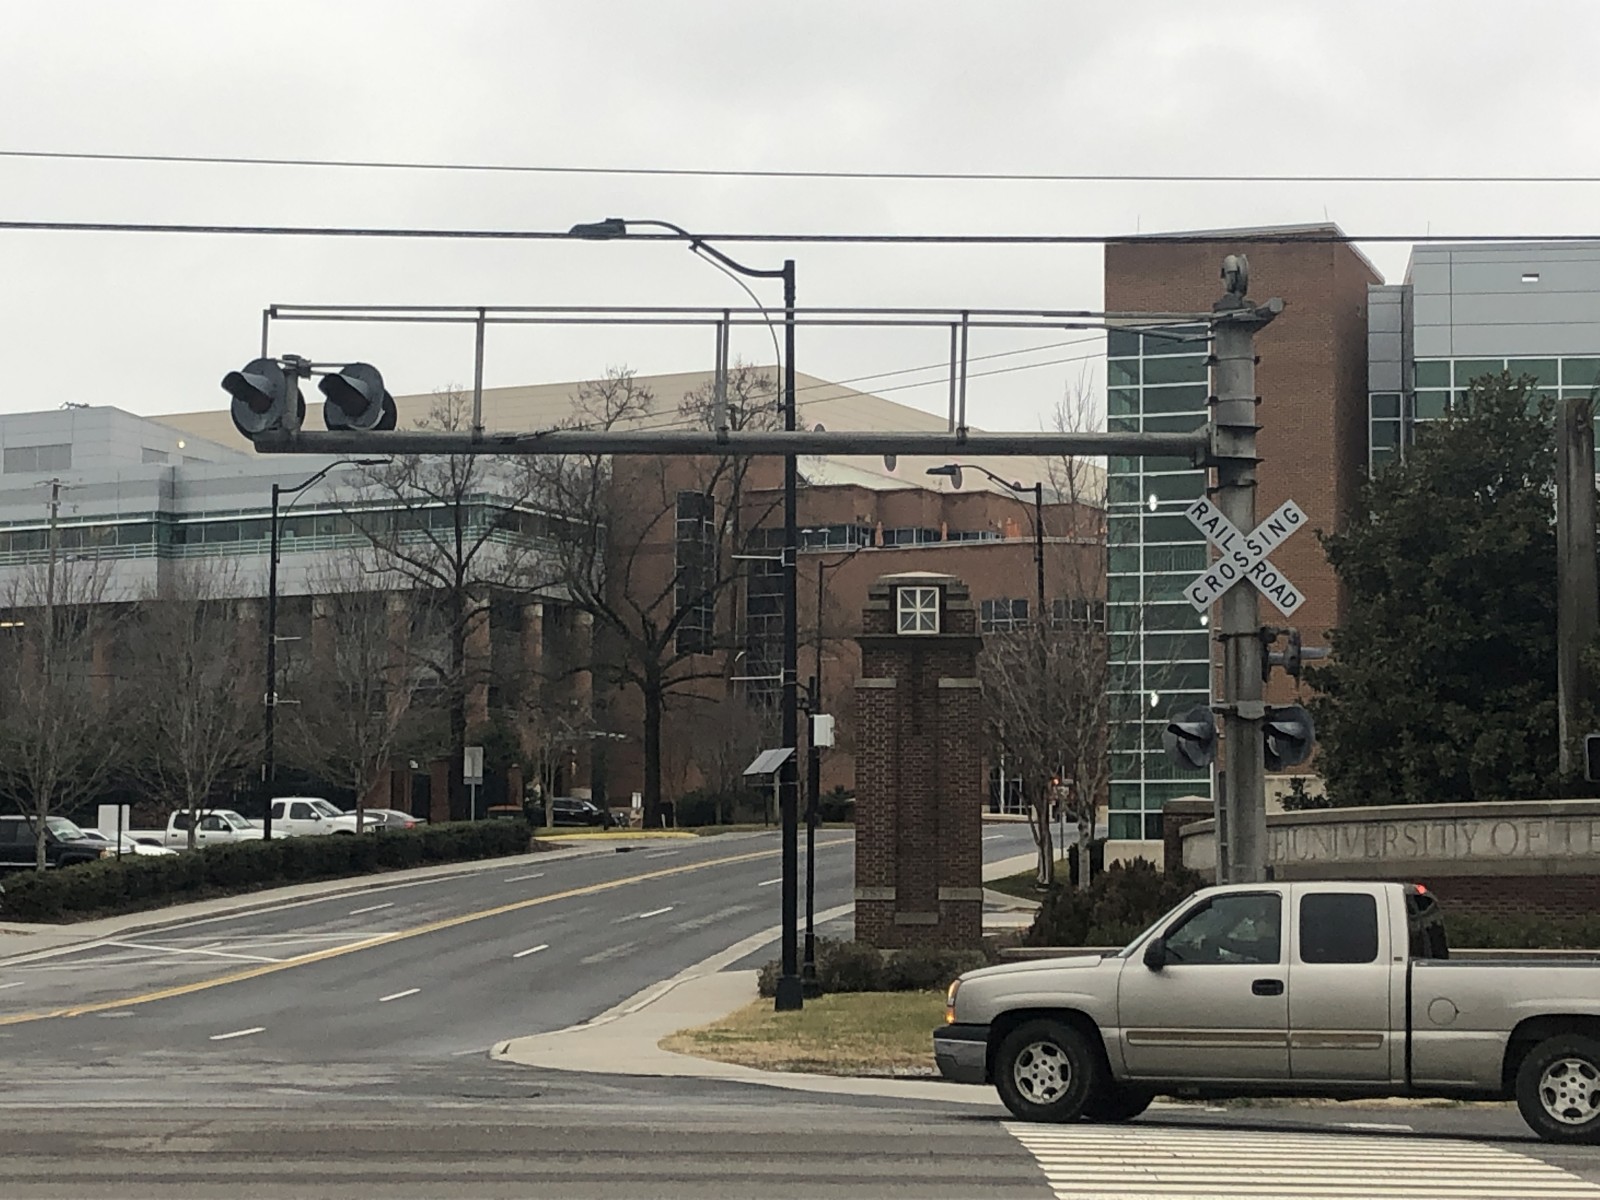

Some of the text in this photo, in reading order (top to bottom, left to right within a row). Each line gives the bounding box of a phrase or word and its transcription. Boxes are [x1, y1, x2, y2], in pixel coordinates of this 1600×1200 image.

[1192, 508, 1300, 604] CROSSING
[1290, 821, 1480, 859] UNIVERSITY
[1491, 820, 1542, 856] OF
